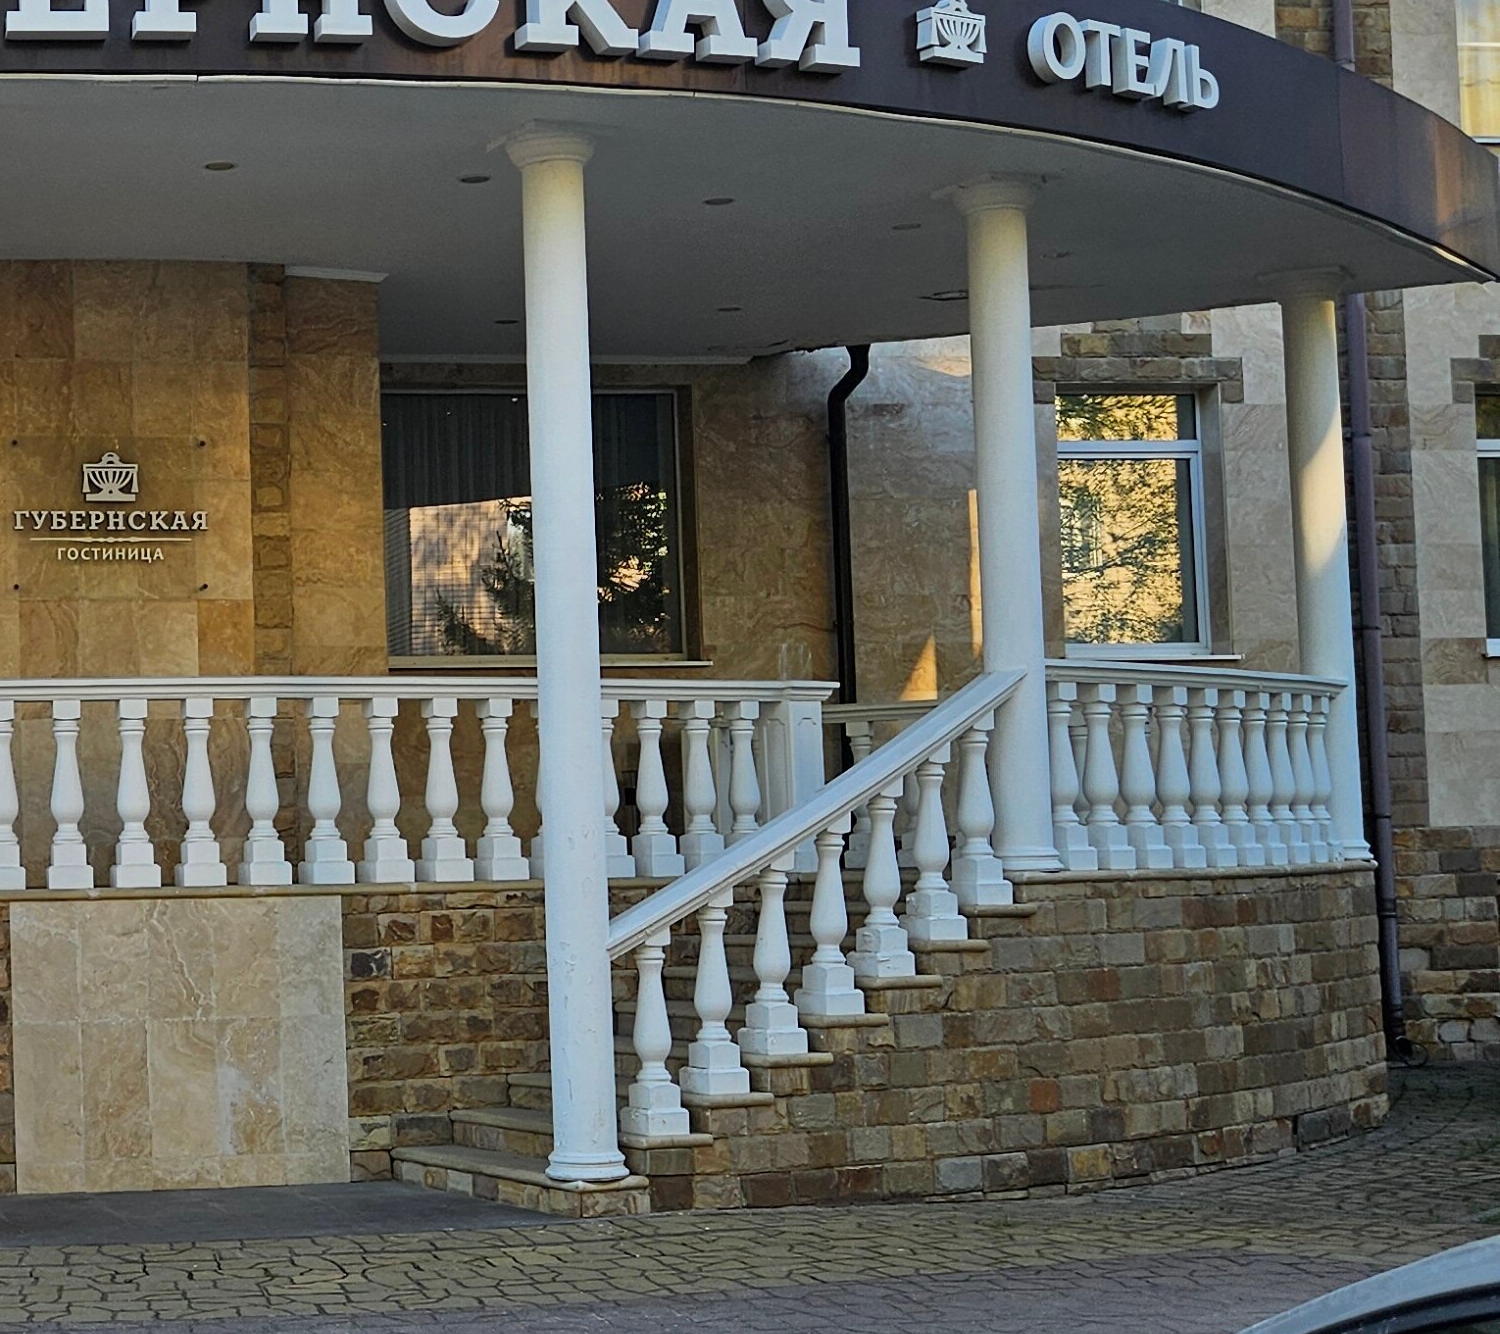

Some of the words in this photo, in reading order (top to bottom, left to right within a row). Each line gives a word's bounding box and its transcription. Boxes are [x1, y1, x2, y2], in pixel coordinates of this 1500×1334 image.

[1027, 11, 1220, 111] ОТЕЛЬ
[13, 510, 209, 530] ГУБЕРНСКАЯ
[57, 546, 164, 563] ГОСТИНИЦА
